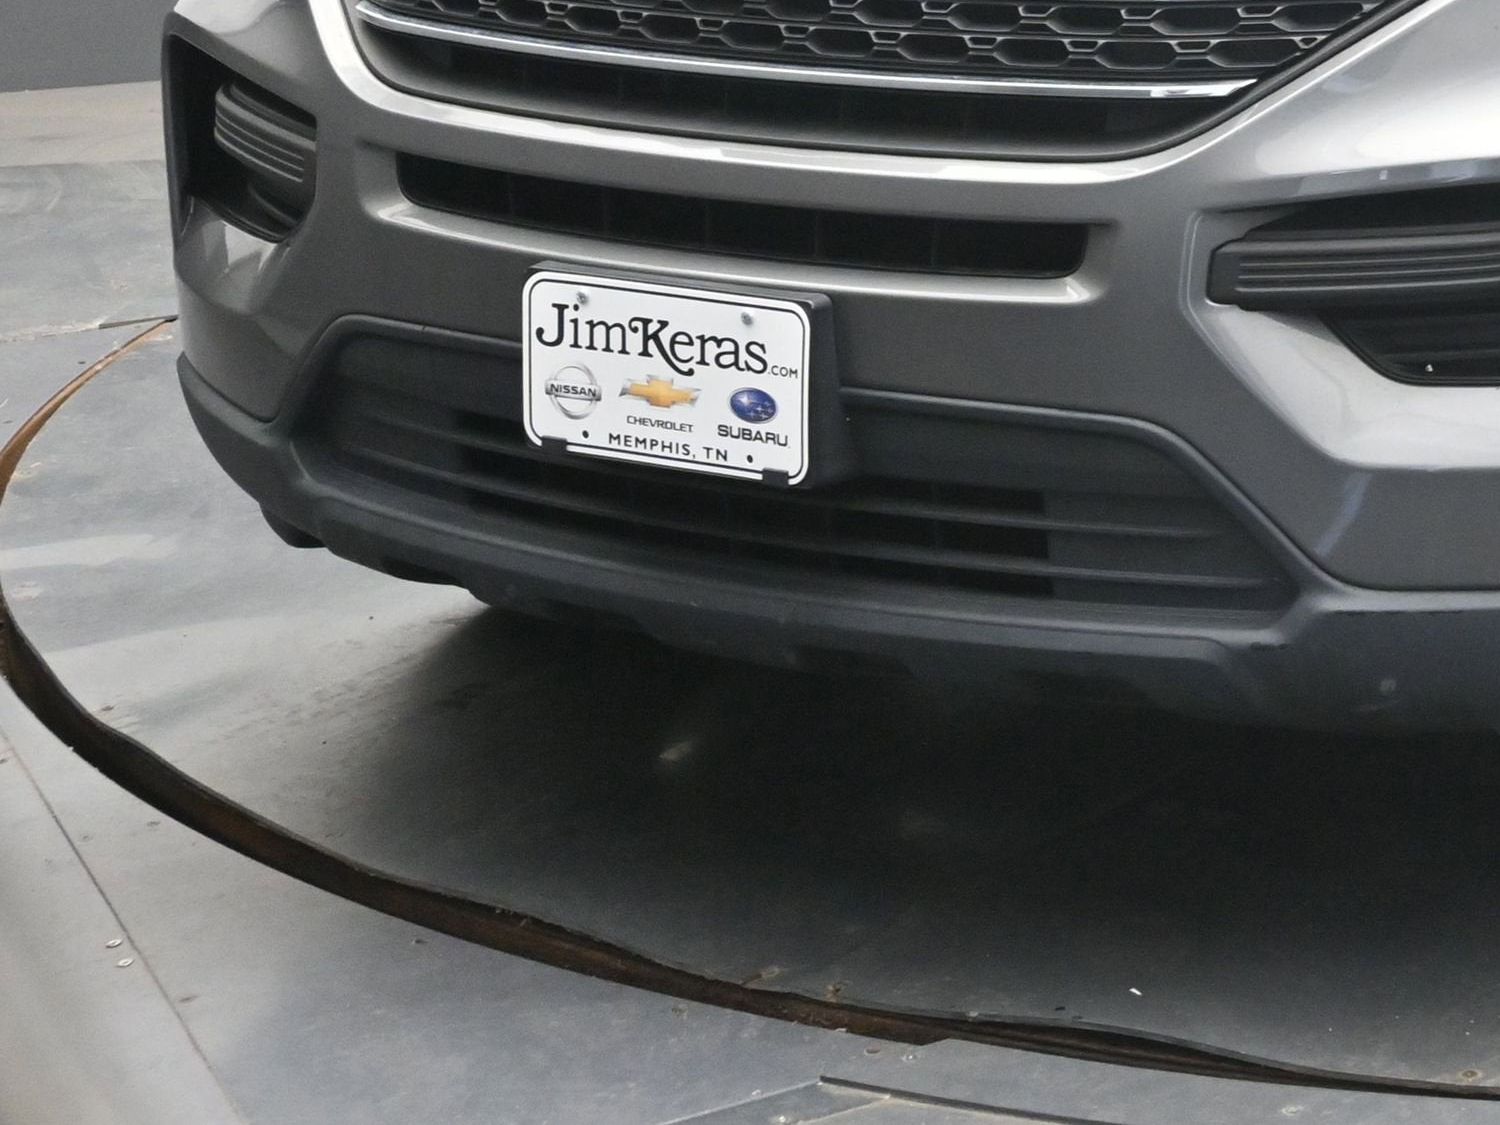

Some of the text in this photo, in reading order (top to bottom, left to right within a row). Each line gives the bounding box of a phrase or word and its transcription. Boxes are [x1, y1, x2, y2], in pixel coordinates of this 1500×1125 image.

[550, 383, 597, 397] NISSAN
[626, 415, 694, 433] CHEVROLET
[717, 424, 788, 447] SUBARU
[608, 432, 728, 462] MEMPHIS, TN
